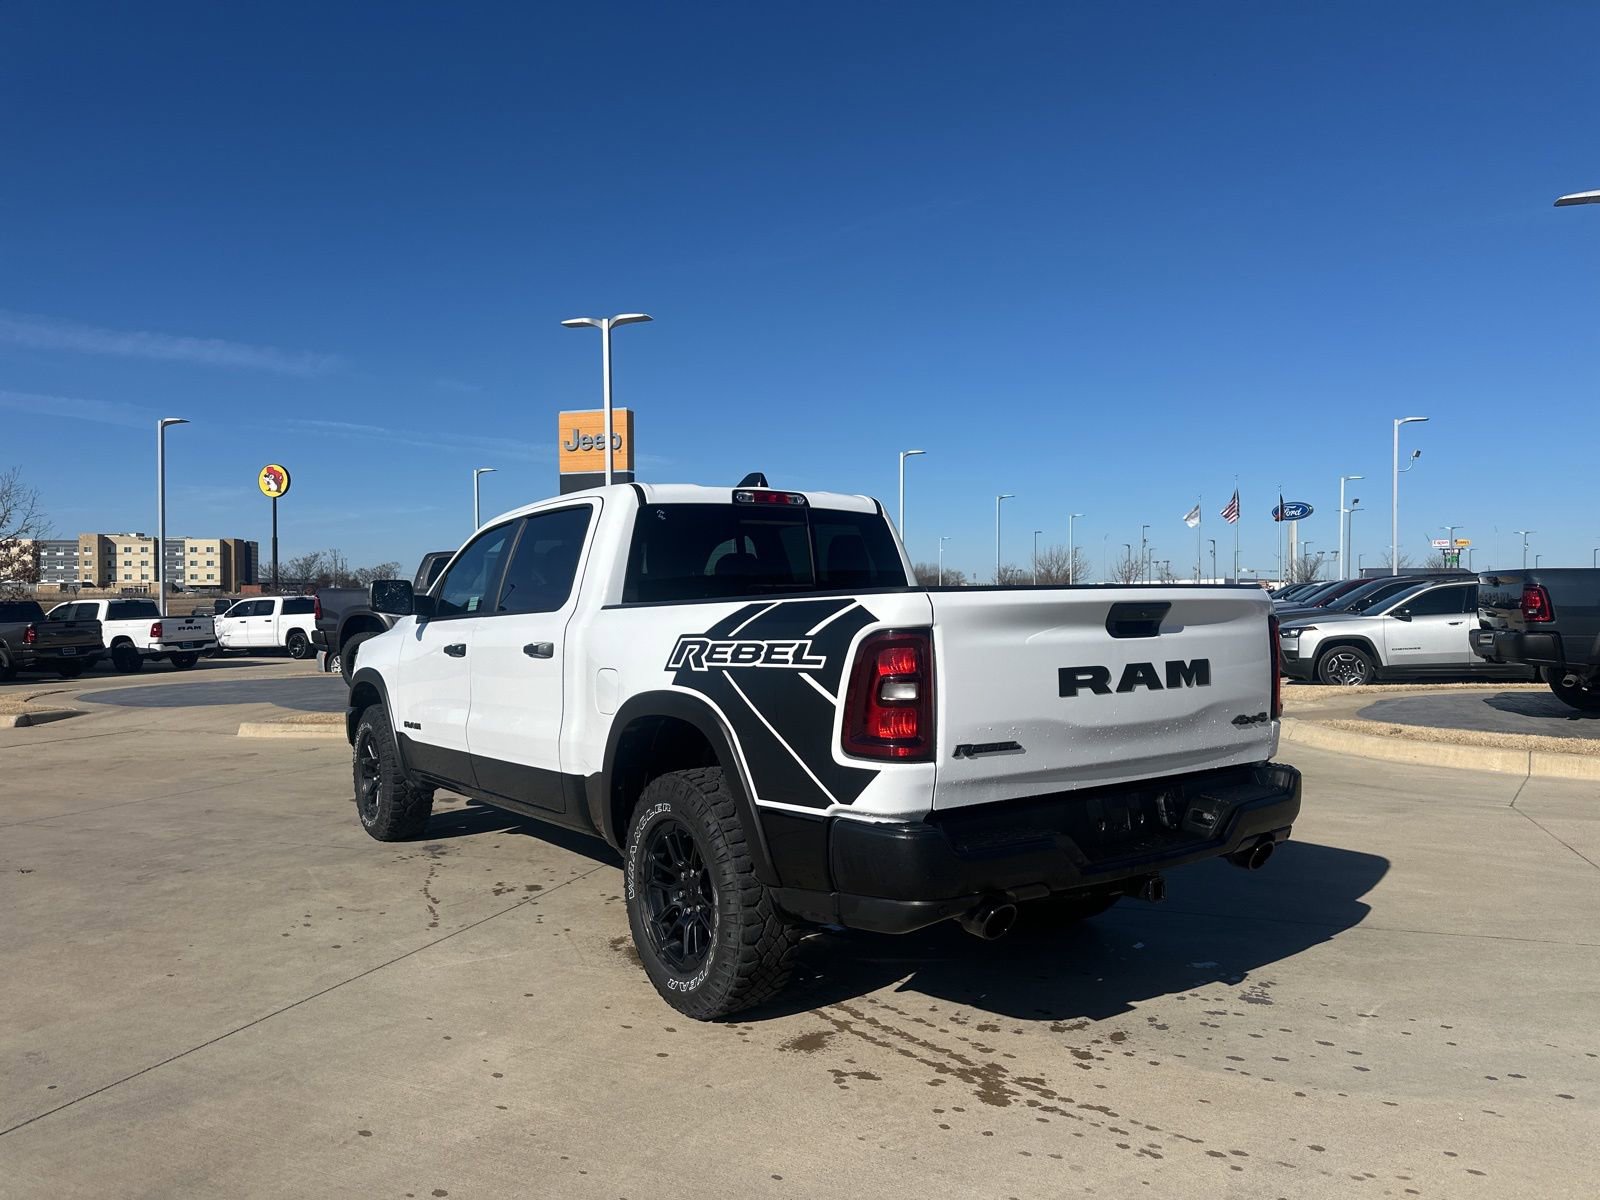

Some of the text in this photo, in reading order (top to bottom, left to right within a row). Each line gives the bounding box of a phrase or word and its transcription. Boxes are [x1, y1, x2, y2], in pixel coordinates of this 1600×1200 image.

[564, 428, 622, 452] Jeep
[668, 637, 828, 672] REBEL
[1058, 658, 1211, 697] RAM
[628, 802, 672, 900] WRANGLER
